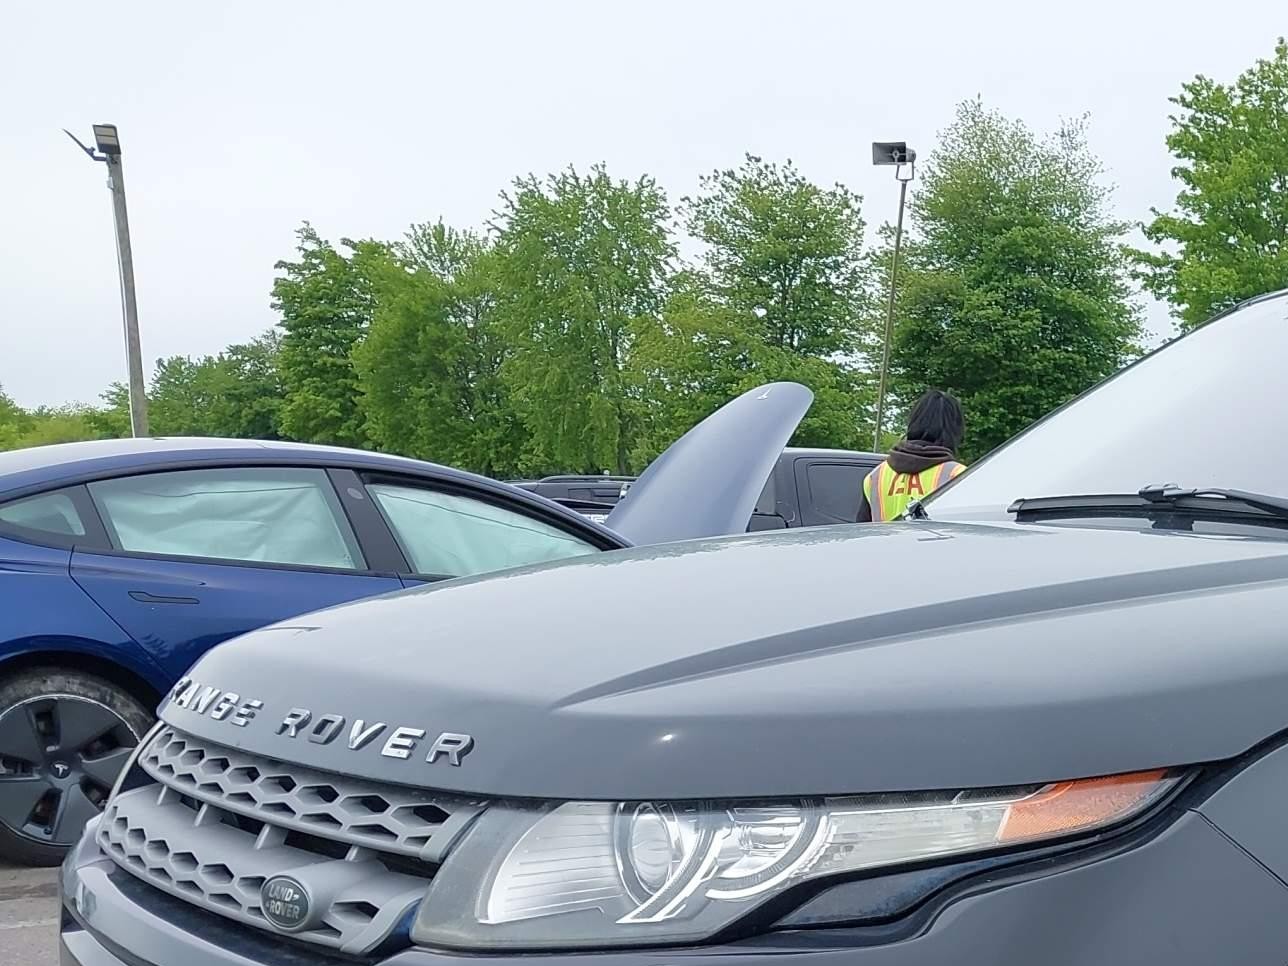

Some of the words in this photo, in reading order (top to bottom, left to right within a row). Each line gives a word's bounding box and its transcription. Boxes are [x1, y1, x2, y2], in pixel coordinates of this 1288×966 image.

[168, 676, 264, 728] RANGE
[275, 707, 476, 767] ROVER
[270, 899, 301, 920] ROVER
